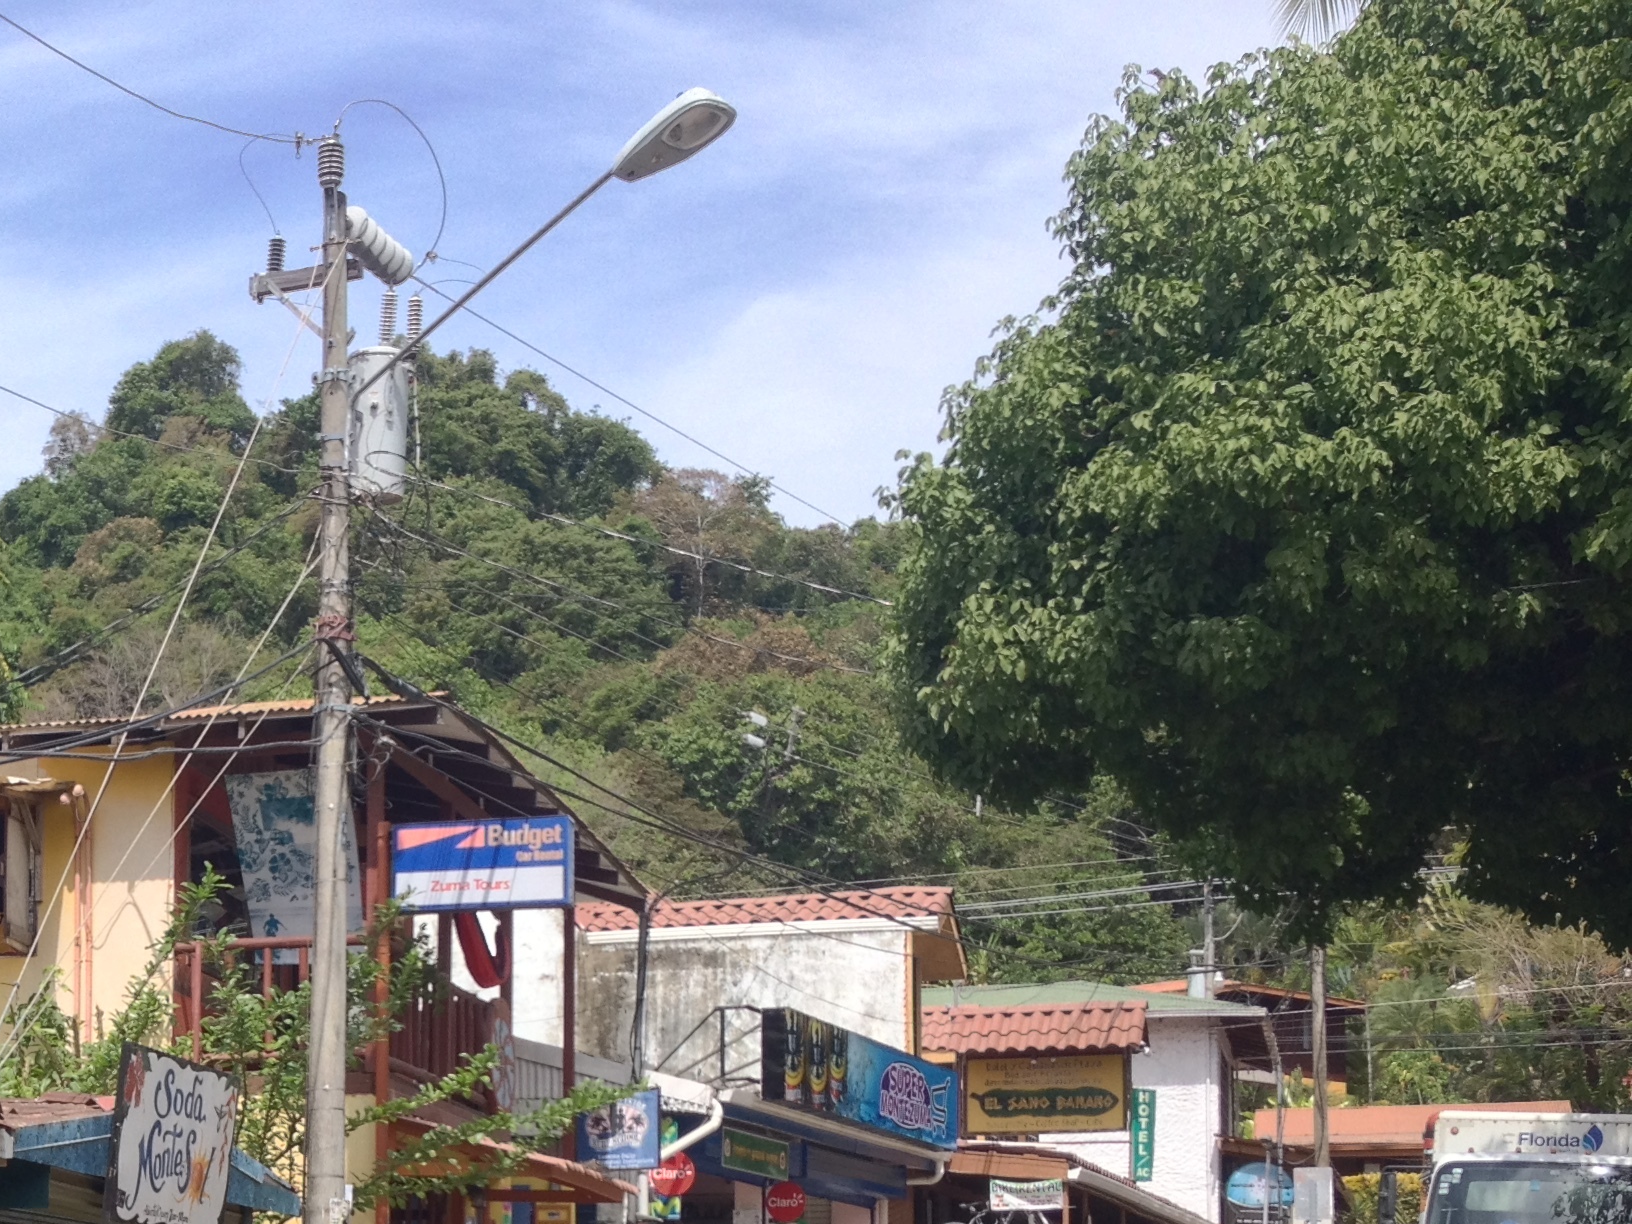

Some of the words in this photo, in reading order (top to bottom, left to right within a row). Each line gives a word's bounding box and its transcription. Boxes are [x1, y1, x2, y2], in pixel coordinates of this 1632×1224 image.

[487, 823, 562, 850] Budget
[431, 880, 470, 892] Zuma
[473, 878, 510, 890] Tours
[888, 1065, 924, 1103] SUPER
[880, 1091, 932, 1131] MONTEZUMA
[984, 1097, 1002, 1110] EL
[1008, 1096, 1050, 1111] SANO
[1518, 1132, 1580, 1147] Florida
[652, 1167, 686, 1180] Claro
[768, 1197, 798, 1208] Claro
